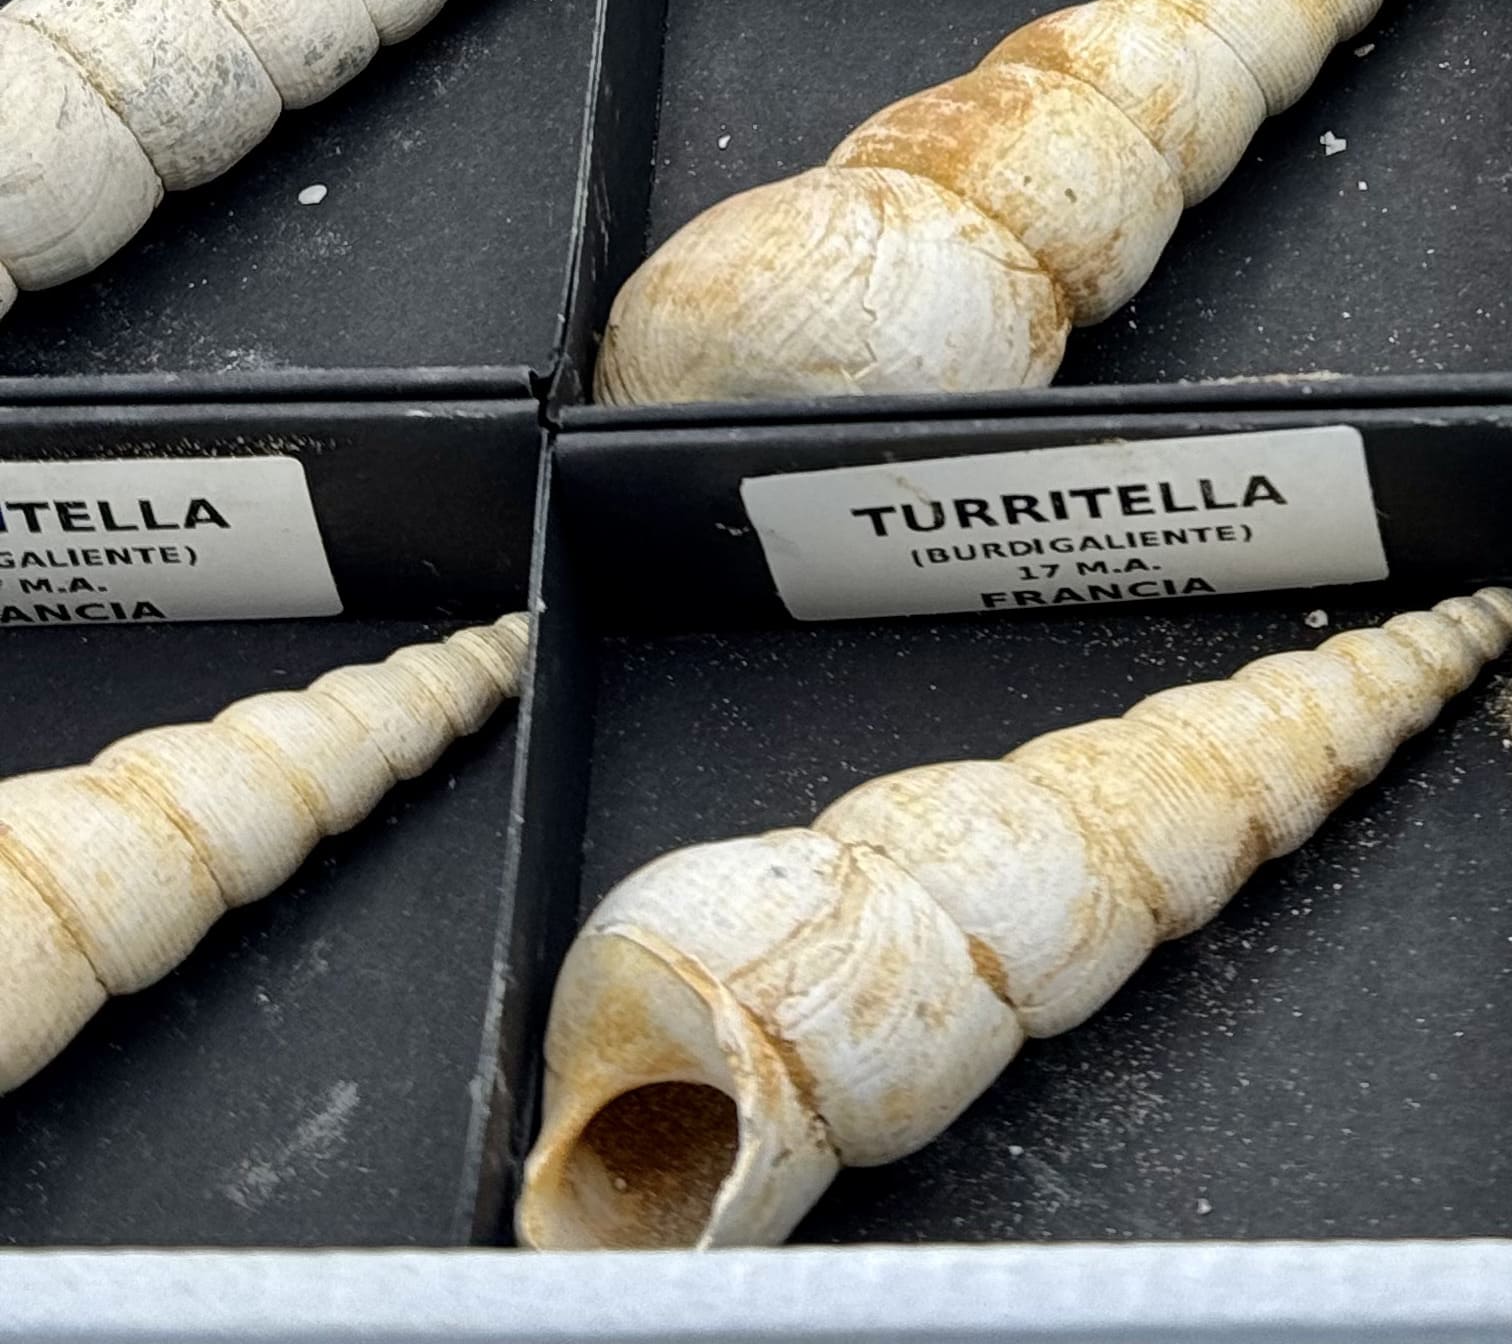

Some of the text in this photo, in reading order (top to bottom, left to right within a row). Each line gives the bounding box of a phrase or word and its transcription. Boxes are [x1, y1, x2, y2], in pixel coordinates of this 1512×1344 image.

[852, 475, 1288, 539] TURRITELLA
[911, 525, 1253, 569] (BURDIGALIENTE)
[20, 577, 108, 593] M.A.
[1017, 559, 1160, 582] 17 M.A.
[981, 576, 1217, 611] FRANCIA
